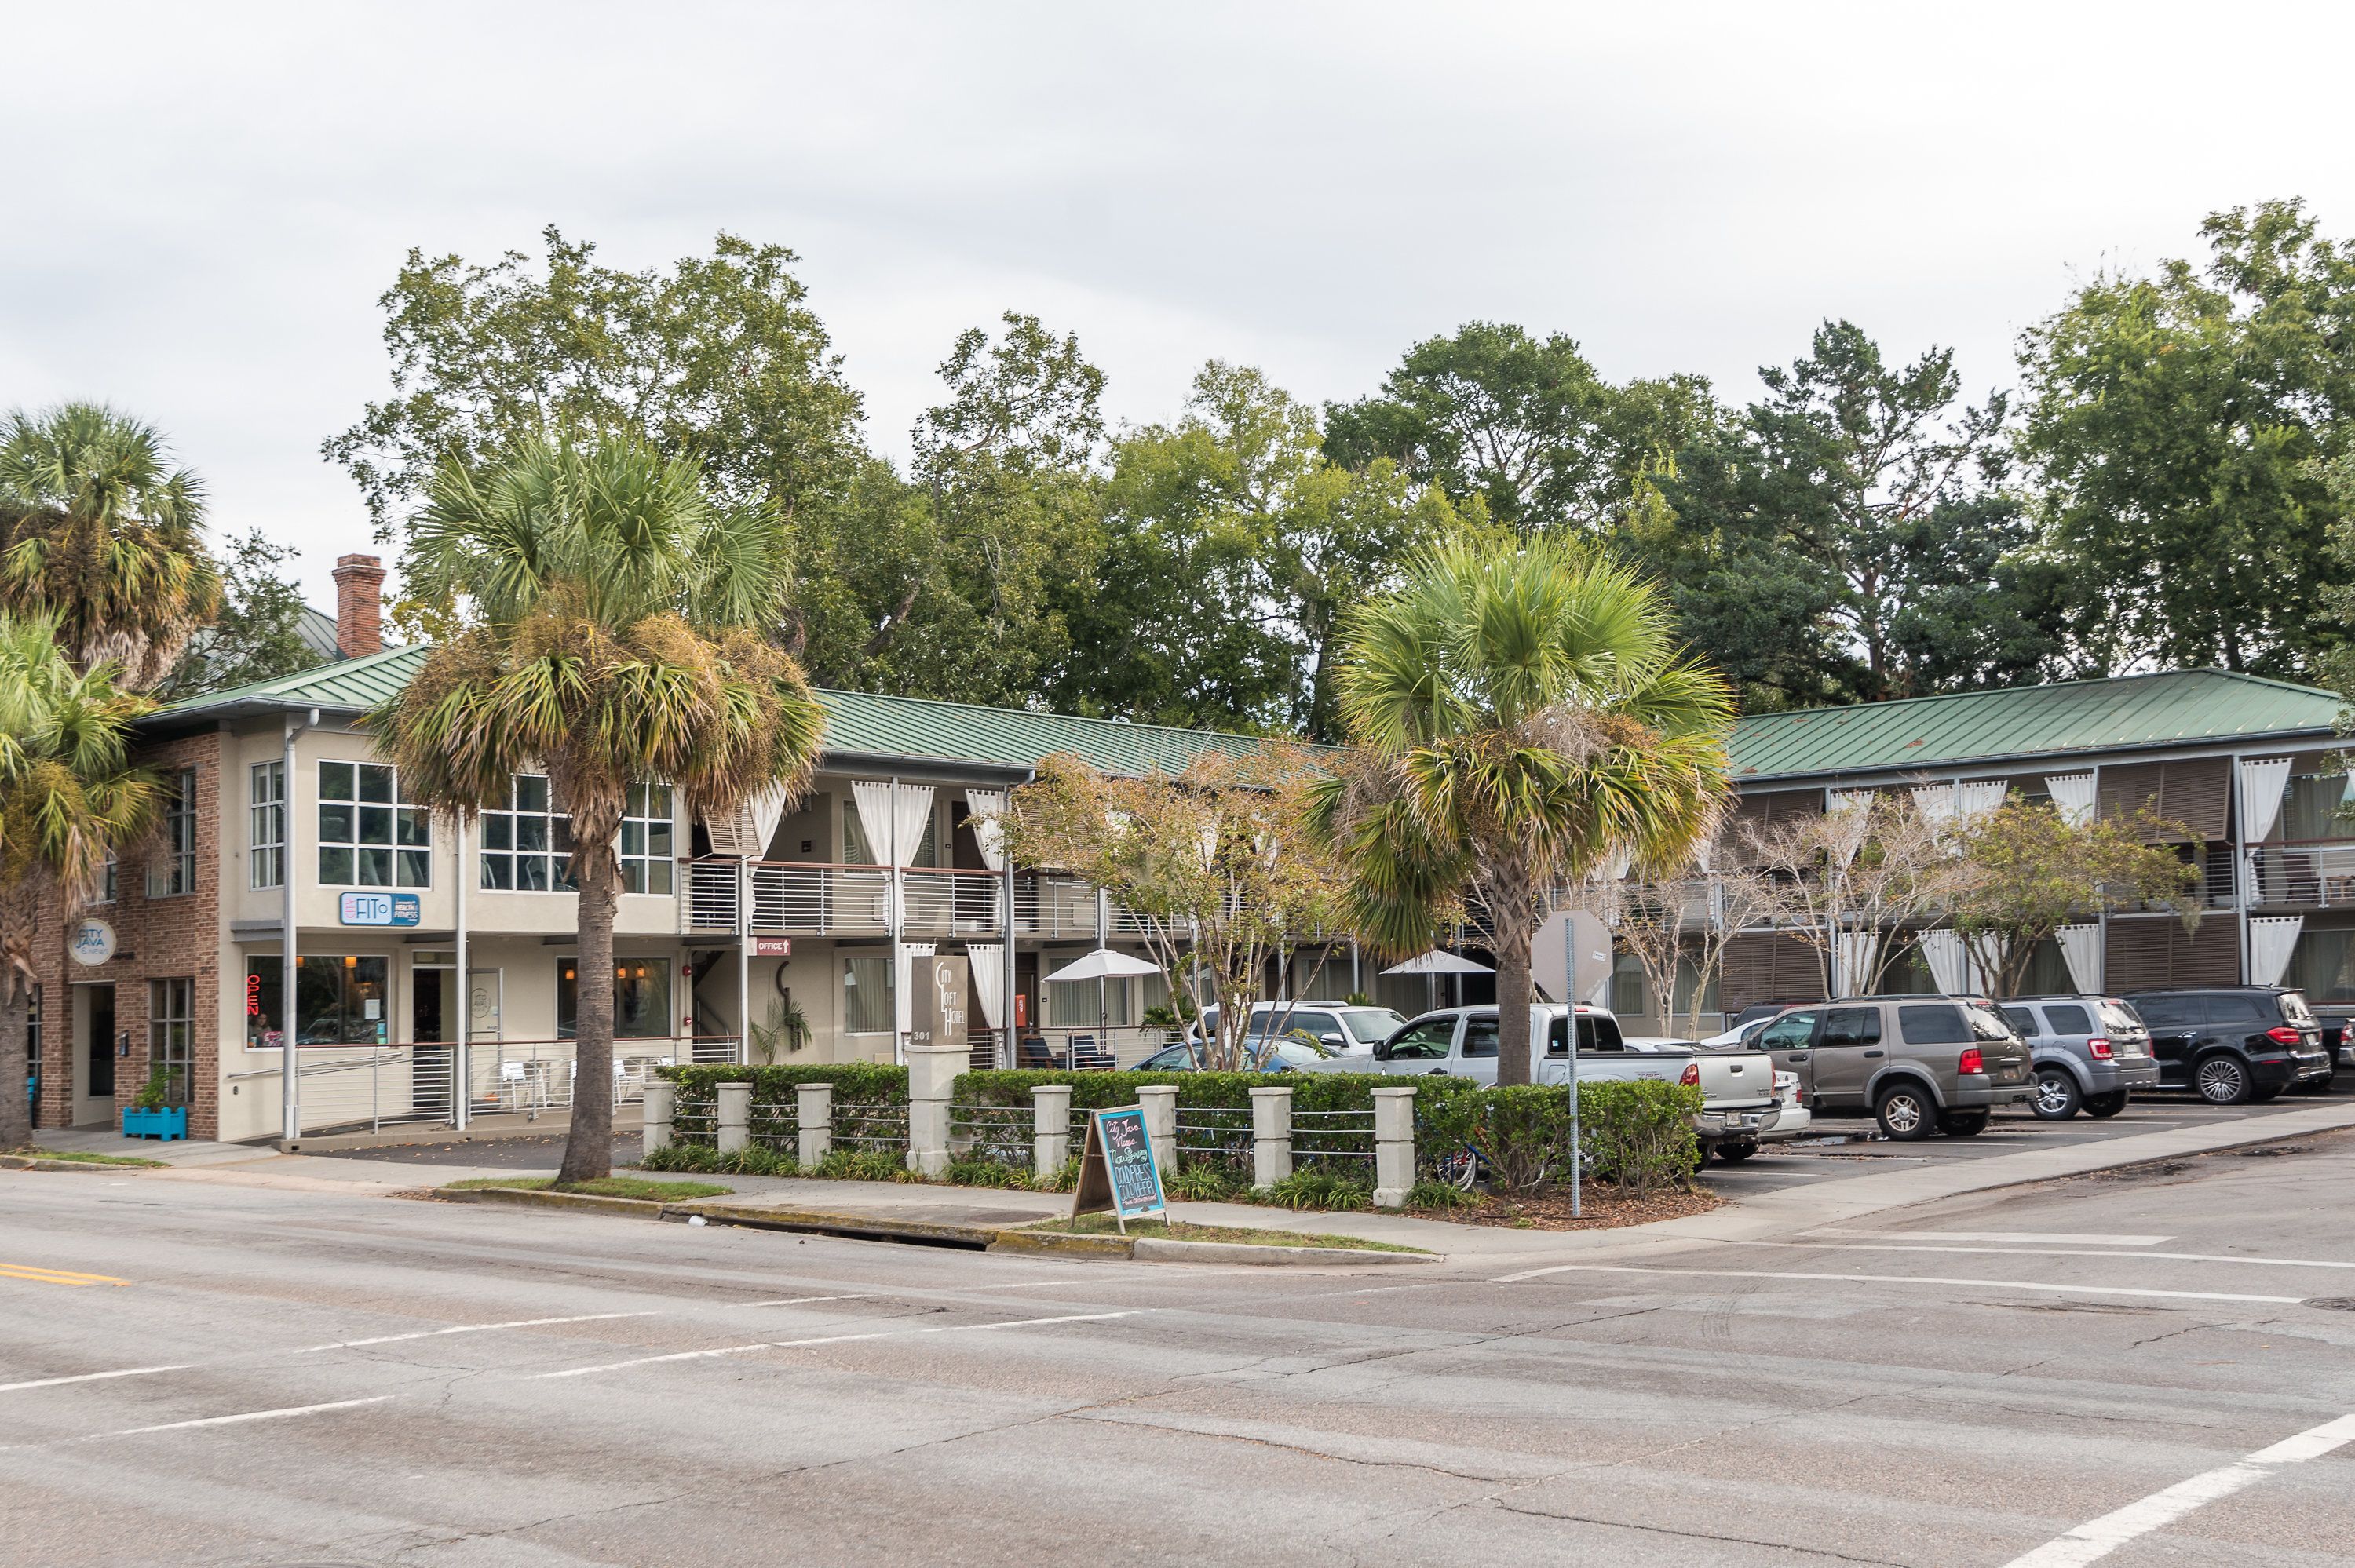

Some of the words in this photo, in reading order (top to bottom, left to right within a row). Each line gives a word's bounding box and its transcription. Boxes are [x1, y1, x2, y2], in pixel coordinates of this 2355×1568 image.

[345, 899, 356, 919] CITY
[75, 938, 105, 948] JAVA
[78, 928, 104, 938] CITY
[758, 942, 783, 950] OFFICE
[935, 961, 952, 989] CITY
[247, 975, 261, 1016] OPEN
[941, 984, 957, 1012] LOFT
[944, 1008, 965, 1036] HOTEL
[914, 1032, 930, 1041] 301
[1106, 1121, 1120, 1140] City
[1121, 1118, 1141, 1137] Java
